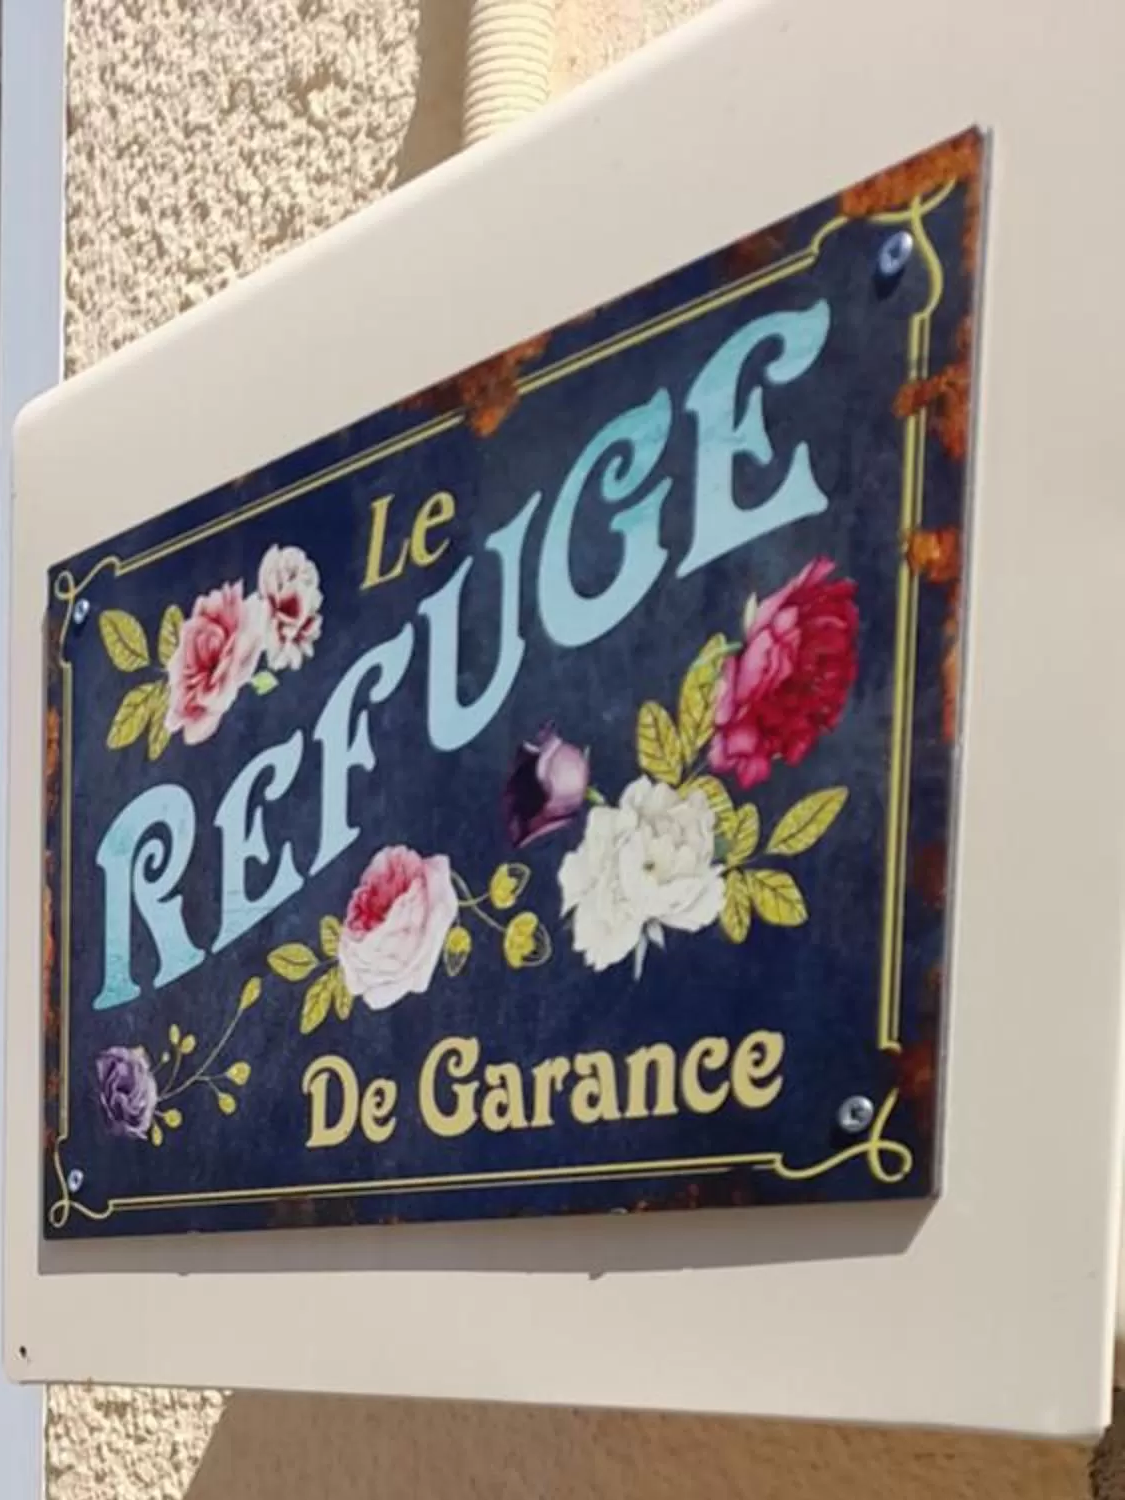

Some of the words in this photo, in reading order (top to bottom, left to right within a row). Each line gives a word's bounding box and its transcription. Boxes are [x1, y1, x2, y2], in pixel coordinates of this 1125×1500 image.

[361, 489, 455, 590] Le
[93, 299, 831, 1010] REFUGE
[303, 1055, 397, 1148] De
[419, 1029, 785, 1136] Garance
